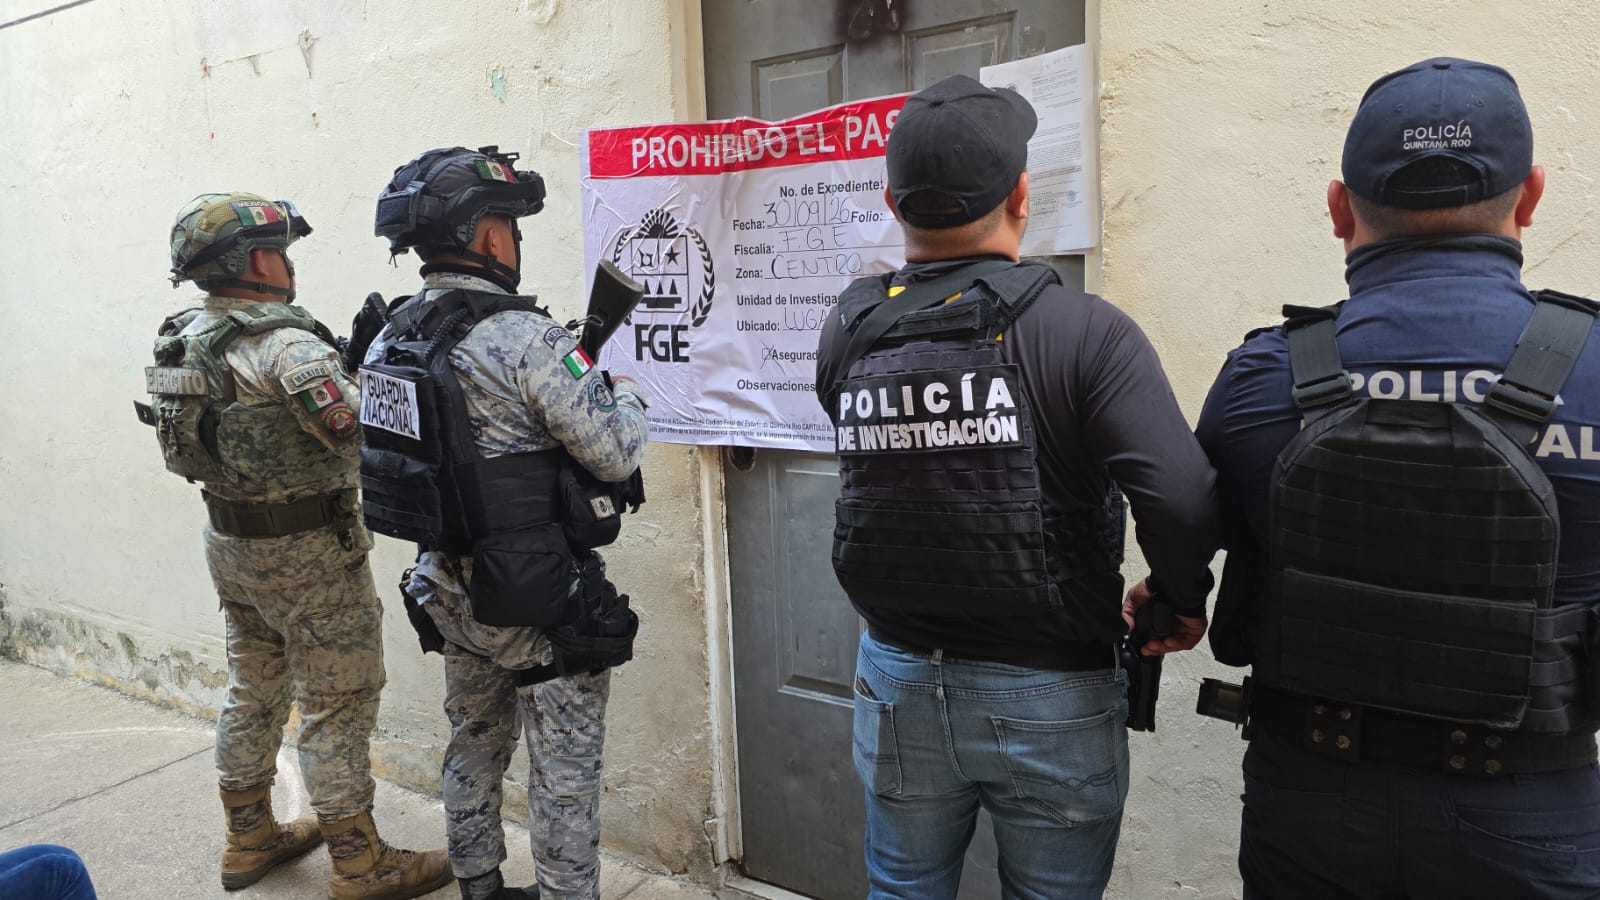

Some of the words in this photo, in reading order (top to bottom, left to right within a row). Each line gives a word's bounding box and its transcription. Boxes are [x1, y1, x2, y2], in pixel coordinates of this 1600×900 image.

[1403, 119, 1472, 141] POLICÍA
[632, 126, 788, 169] PROHIBIDO
[796, 122, 836, 156] EL
[1403, 140, 1449, 150] QUINTANA
[1450, 139, 1471, 148] ROO
[780, 186, 798, 198] No.
[801, 184, 814, 195] de
[817, 179, 884, 196] Expediente:
[733, 218, 766, 231] Fecha:
[851, 210, 883, 223] Folio:
[735, 268, 763, 279] Zona:
[771, 251, 862, 279] CENTRO
[736, 294, 772, 306] Unidad
[775, 294, 787, 305] de
[790, 293, 841, 307] Investiga
[736, 320, 780, 332] Ubicado:
[635, 324, 690, 363] FGE
[367, 374, 411, 409] GUARDIA
[839, 372, 1016, 420] POLICÍA
[364, 397, 416, 437] NACIONAL
[838, 426, 855, 451] DE
[858, 411, 1018, 450] INVESTIGACIÓN
